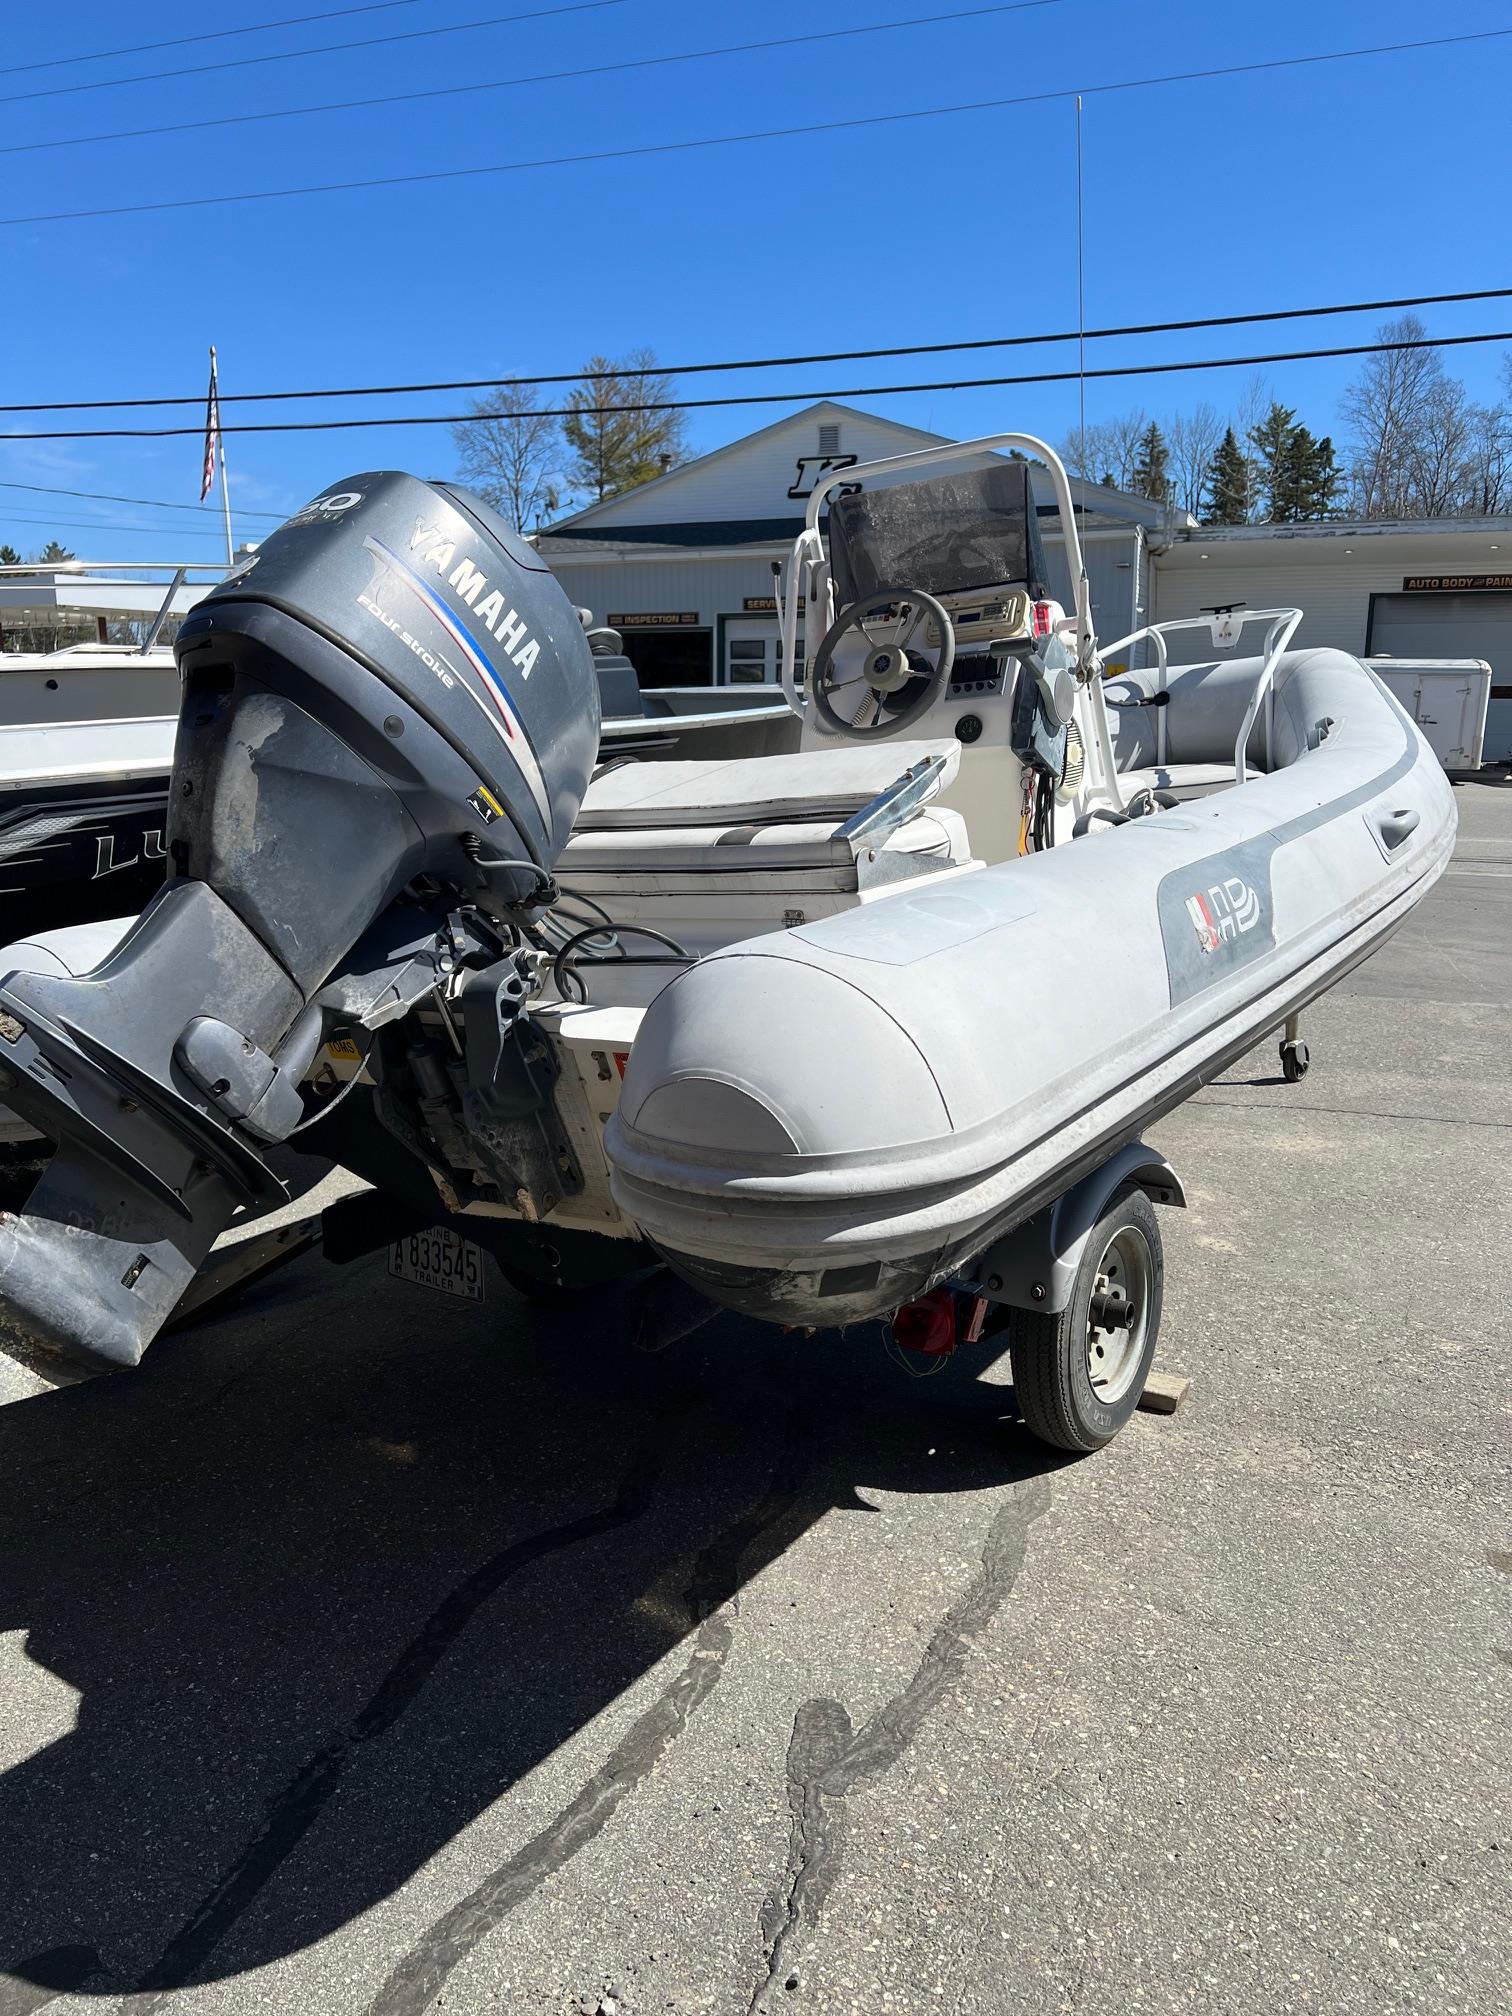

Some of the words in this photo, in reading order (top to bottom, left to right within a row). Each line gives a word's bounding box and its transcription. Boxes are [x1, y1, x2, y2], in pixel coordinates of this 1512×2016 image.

[1408, 579, 1439, 589] AUTO
[1442, 578, 1474, 588] BODY
[410, 515, 541, 681] YAMAHA
[747, 600, 785, 609] SERVIE
[624, 615, 679, 625] INSPECTION
[425, 1227, 451, 1241] AINE
[410, 1235, 478, 1284] 833545
[414, 1268, 454, 1291] TRAILER
